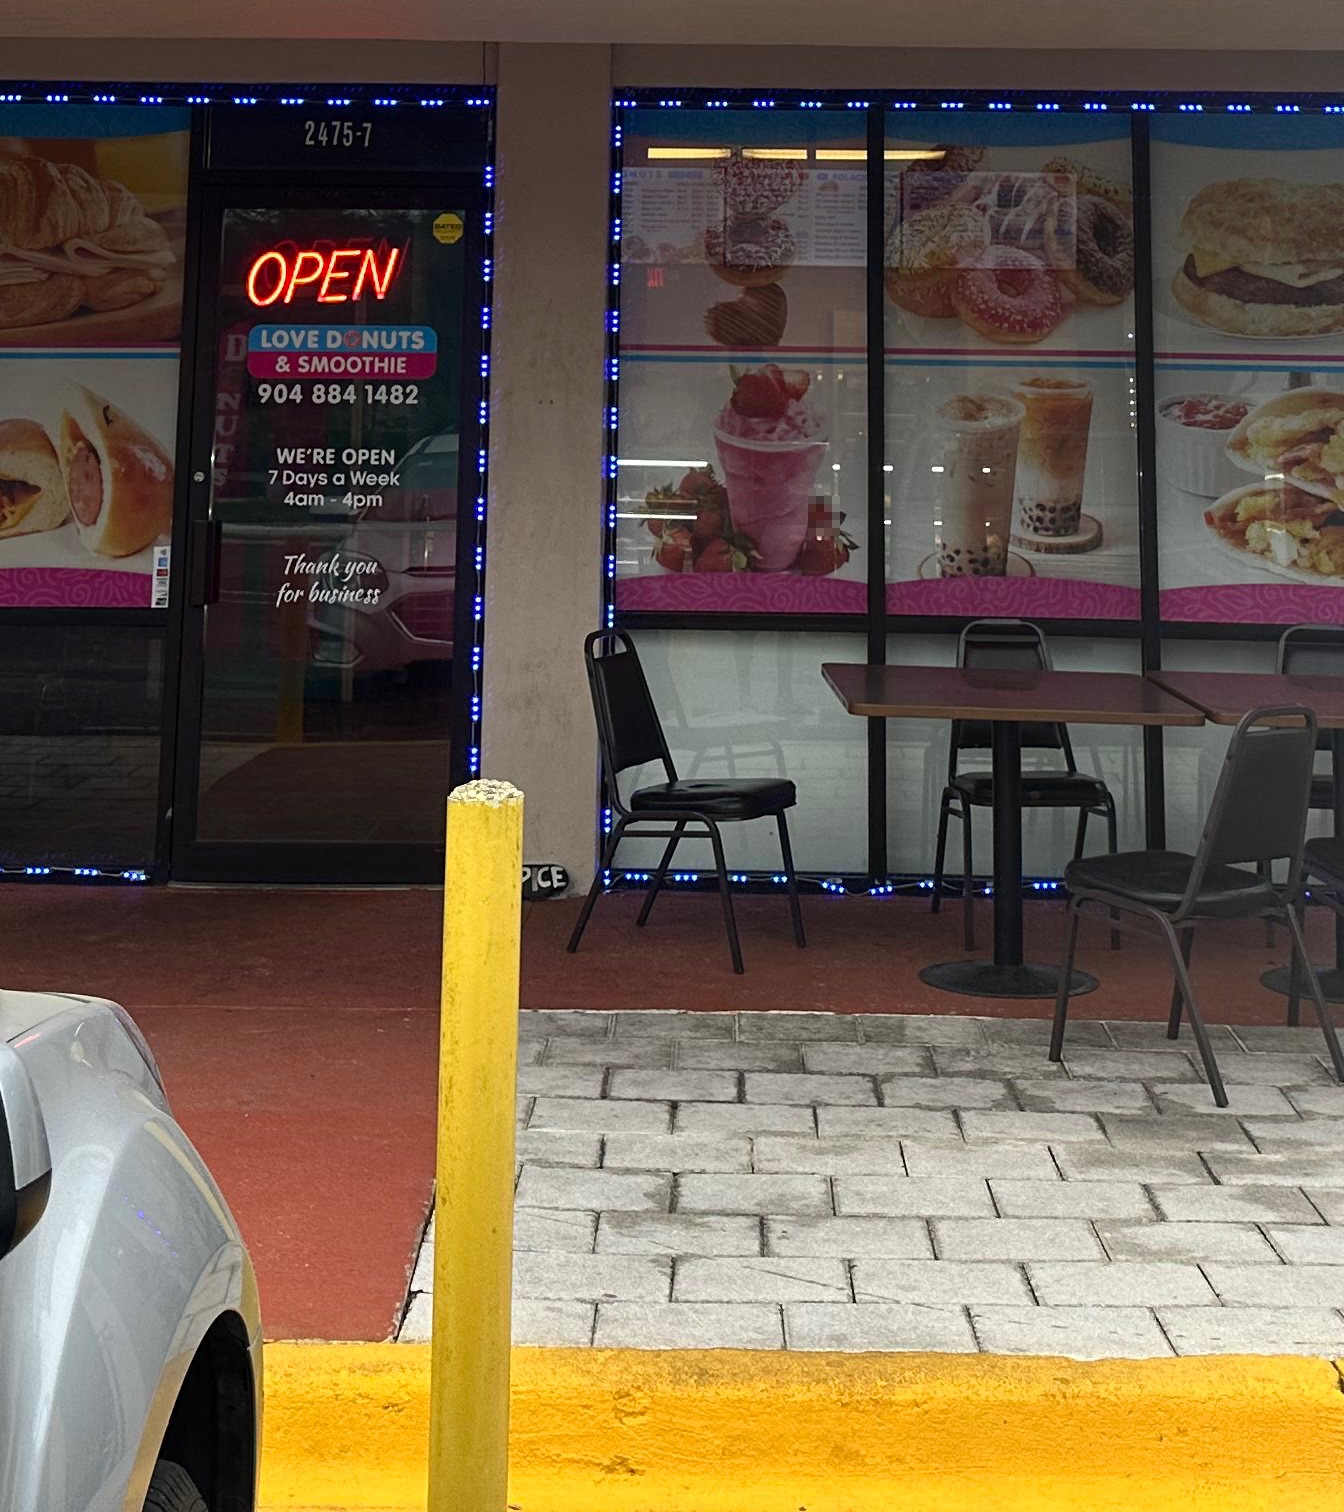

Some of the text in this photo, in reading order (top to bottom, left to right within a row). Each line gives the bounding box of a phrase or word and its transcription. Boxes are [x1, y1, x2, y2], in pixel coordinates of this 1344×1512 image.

[304, 120, 373, 148] 2475-7
[246, 246, 401, 307] OPEN
[260, 330, 424, 350] LOVE DONUTS
[275, 355, 407, 374] & SMOOTHIE
[257, 384, 419, 405] 904 884 1482
[341, 448, 395, 465] OPEN
[267, 469, 400, 488] 7 Days a Week
[283, 491, 325, 507] 4am
[341, 491, 383, 510] 4pm
[284, 553, 378, 581] Thank you
[275, 582, 382, 608] for business
